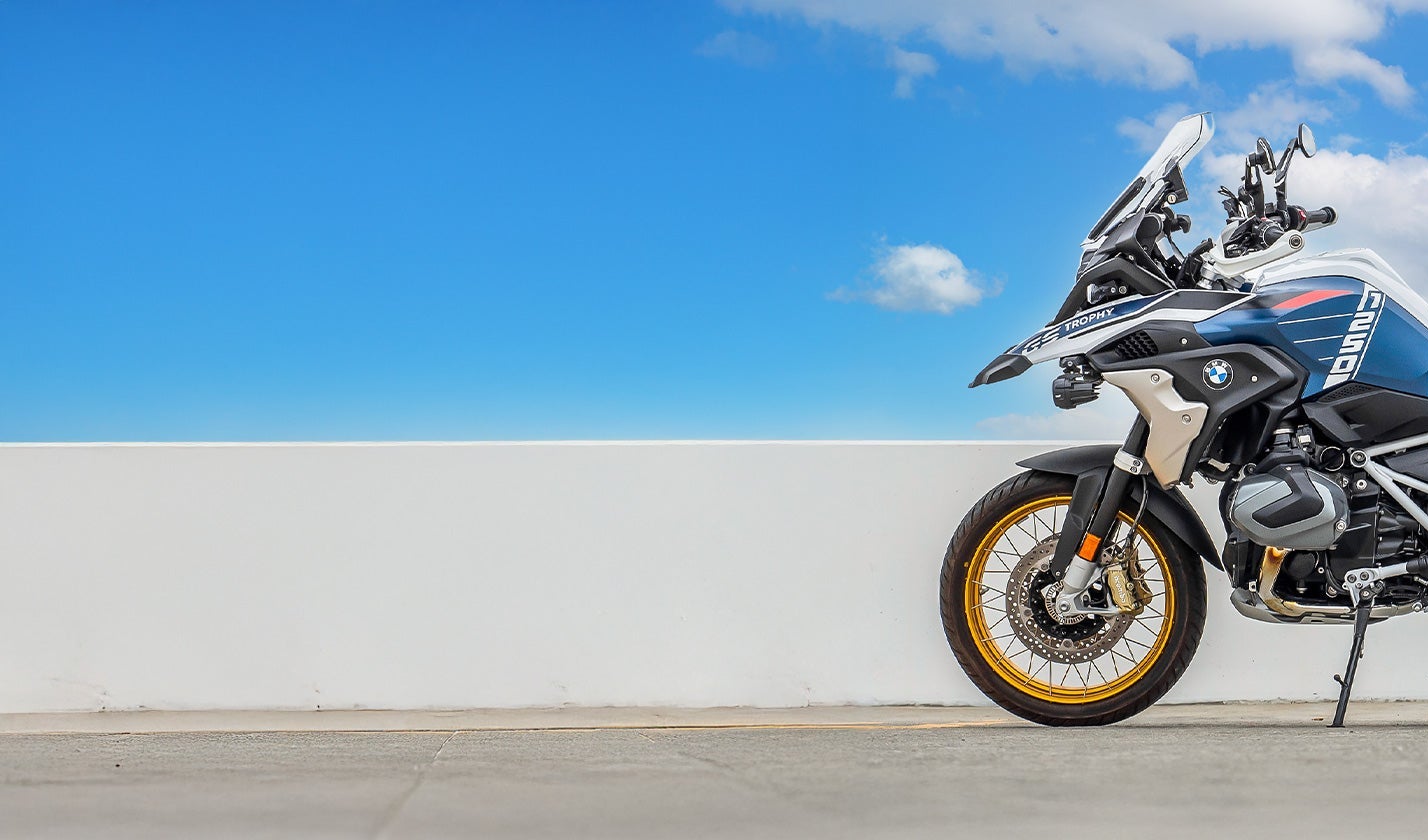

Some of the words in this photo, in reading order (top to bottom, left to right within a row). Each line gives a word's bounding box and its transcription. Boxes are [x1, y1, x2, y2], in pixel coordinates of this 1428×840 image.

[1022, 327, 1061, 352] GS
[1065, 307, 1115, 332] TROPHY
[1329, 292, 1382, 374] 1250
[1205, 361, 1228, 373] BMW
